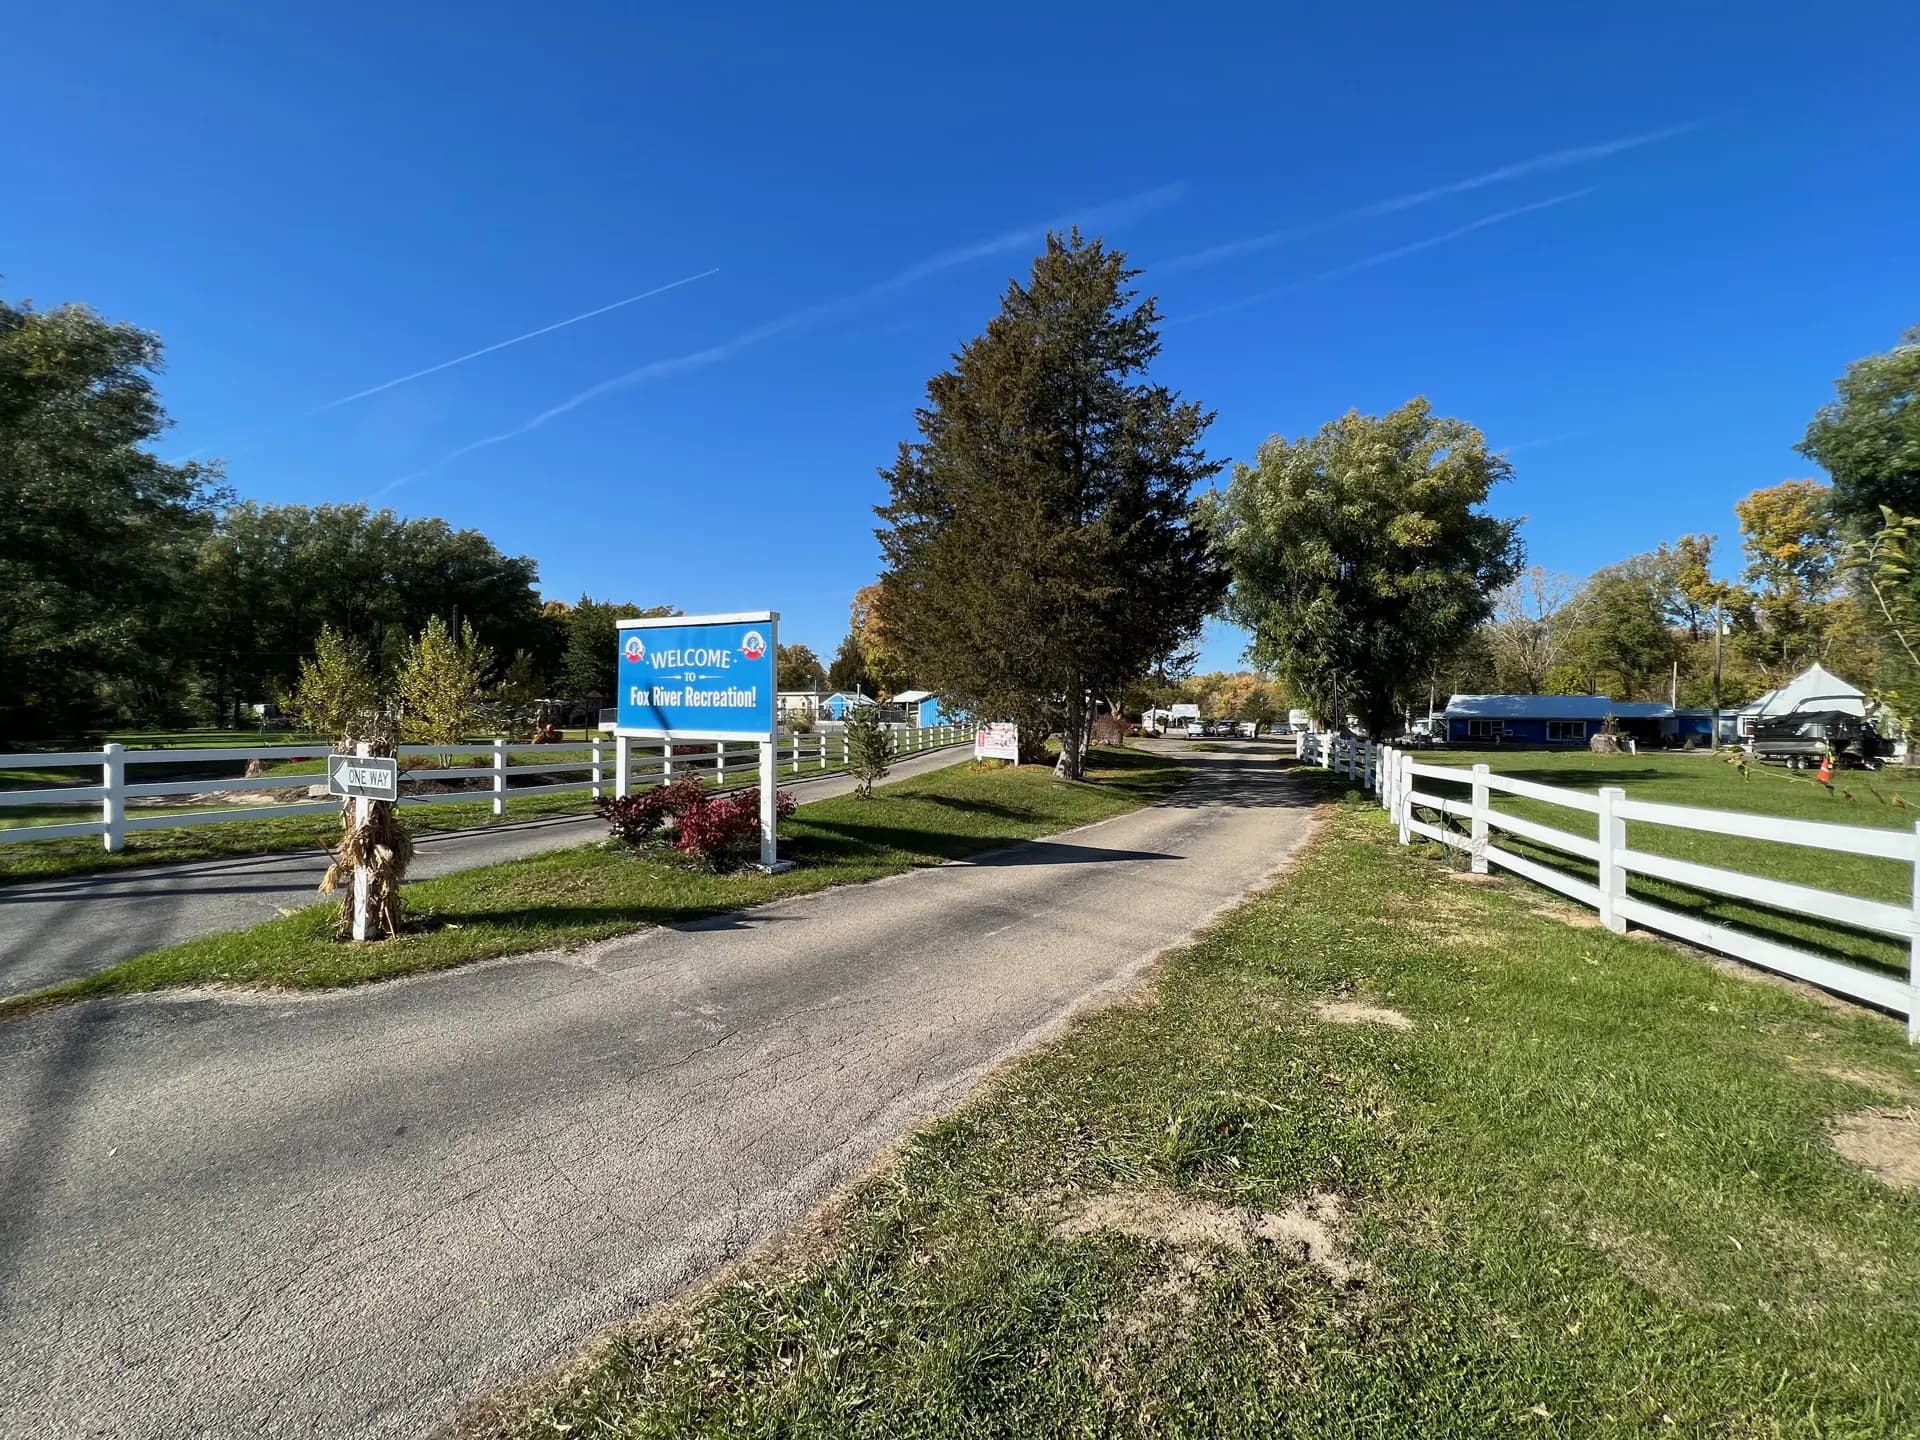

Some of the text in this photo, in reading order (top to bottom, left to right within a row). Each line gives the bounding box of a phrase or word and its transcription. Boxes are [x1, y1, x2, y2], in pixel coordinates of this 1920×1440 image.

[651, 649, 731, 669] WELCOME
[684, 672, 696, 682] TO
[631, 686, 757, 707] Fox River Recreation!
[349, 769, 388, 786] ONE WAY
